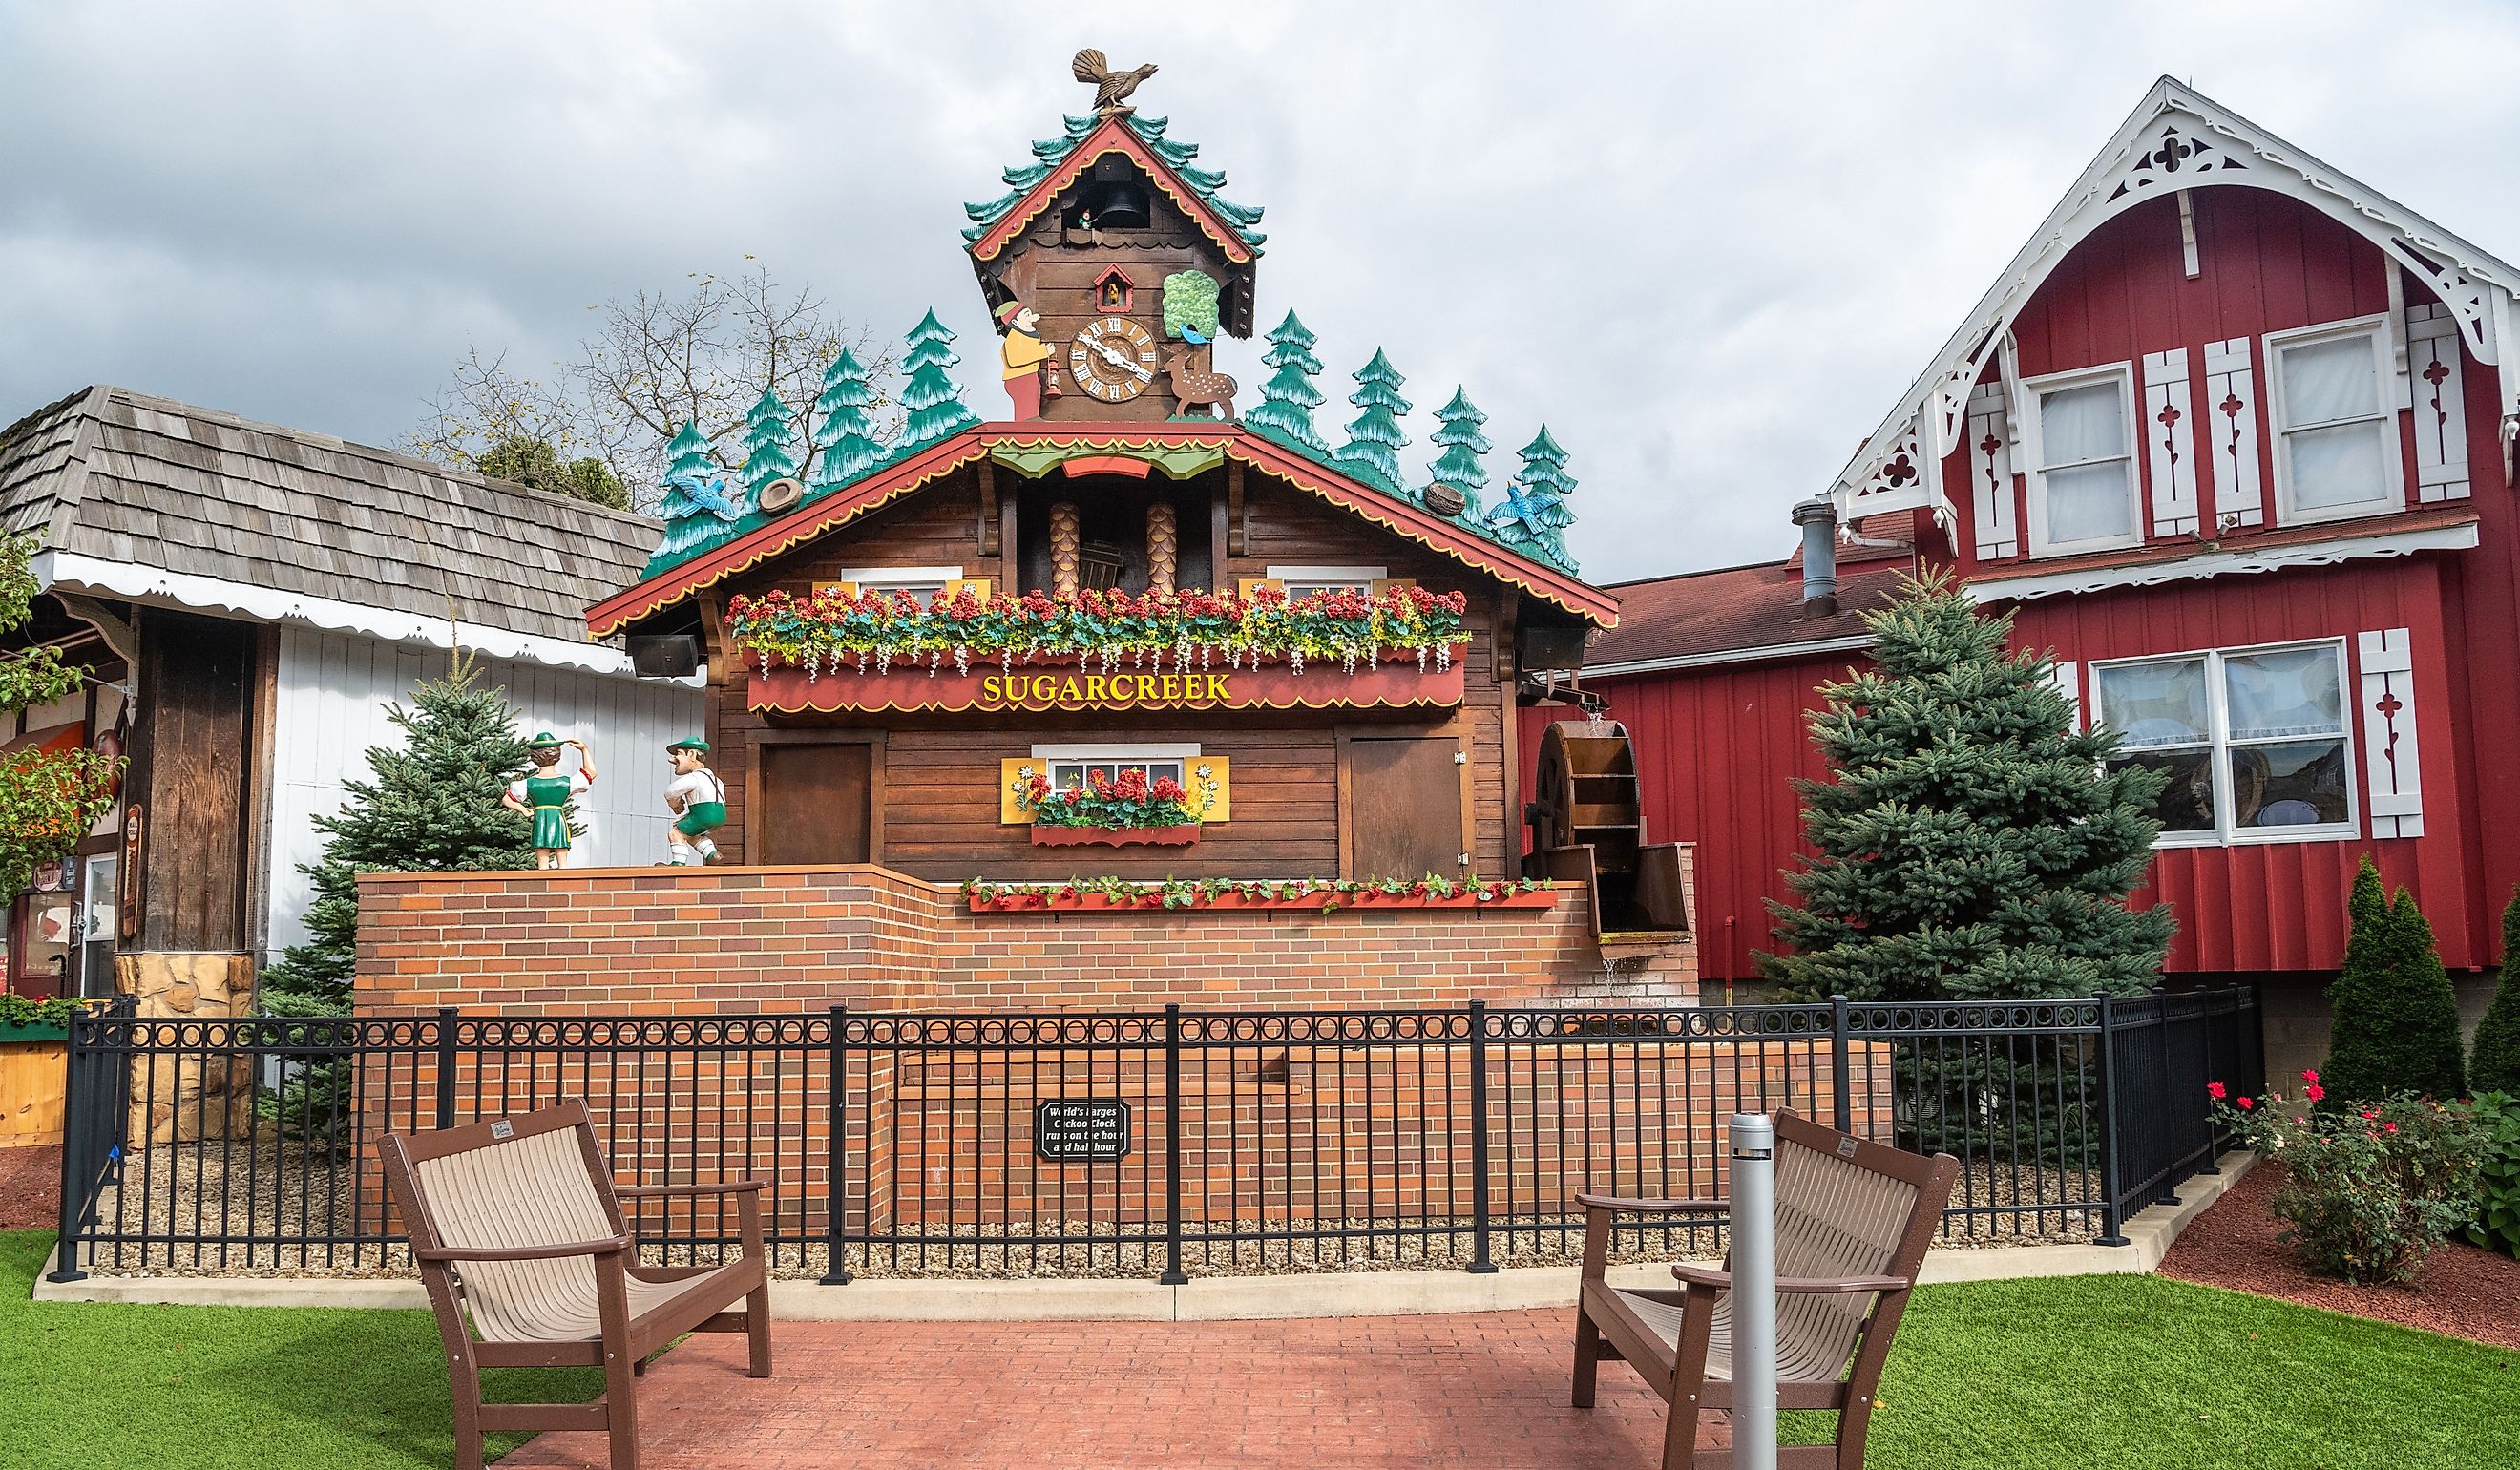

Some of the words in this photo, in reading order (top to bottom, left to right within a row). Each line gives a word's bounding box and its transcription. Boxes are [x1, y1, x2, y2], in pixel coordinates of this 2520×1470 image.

[983, 673, 1231, 703] SUGARCREEK
[1054, 1119, 1087, 1128] Cckoo
[1092, 1119, 1116, 1128] Clock
[1083, 1131, 1100, 1140] te
[1054, 1143, 1072, 1151] ad
[1074, 1143, 1089, 1151] hal
[1094, 1143, 1117, 1151] hour
